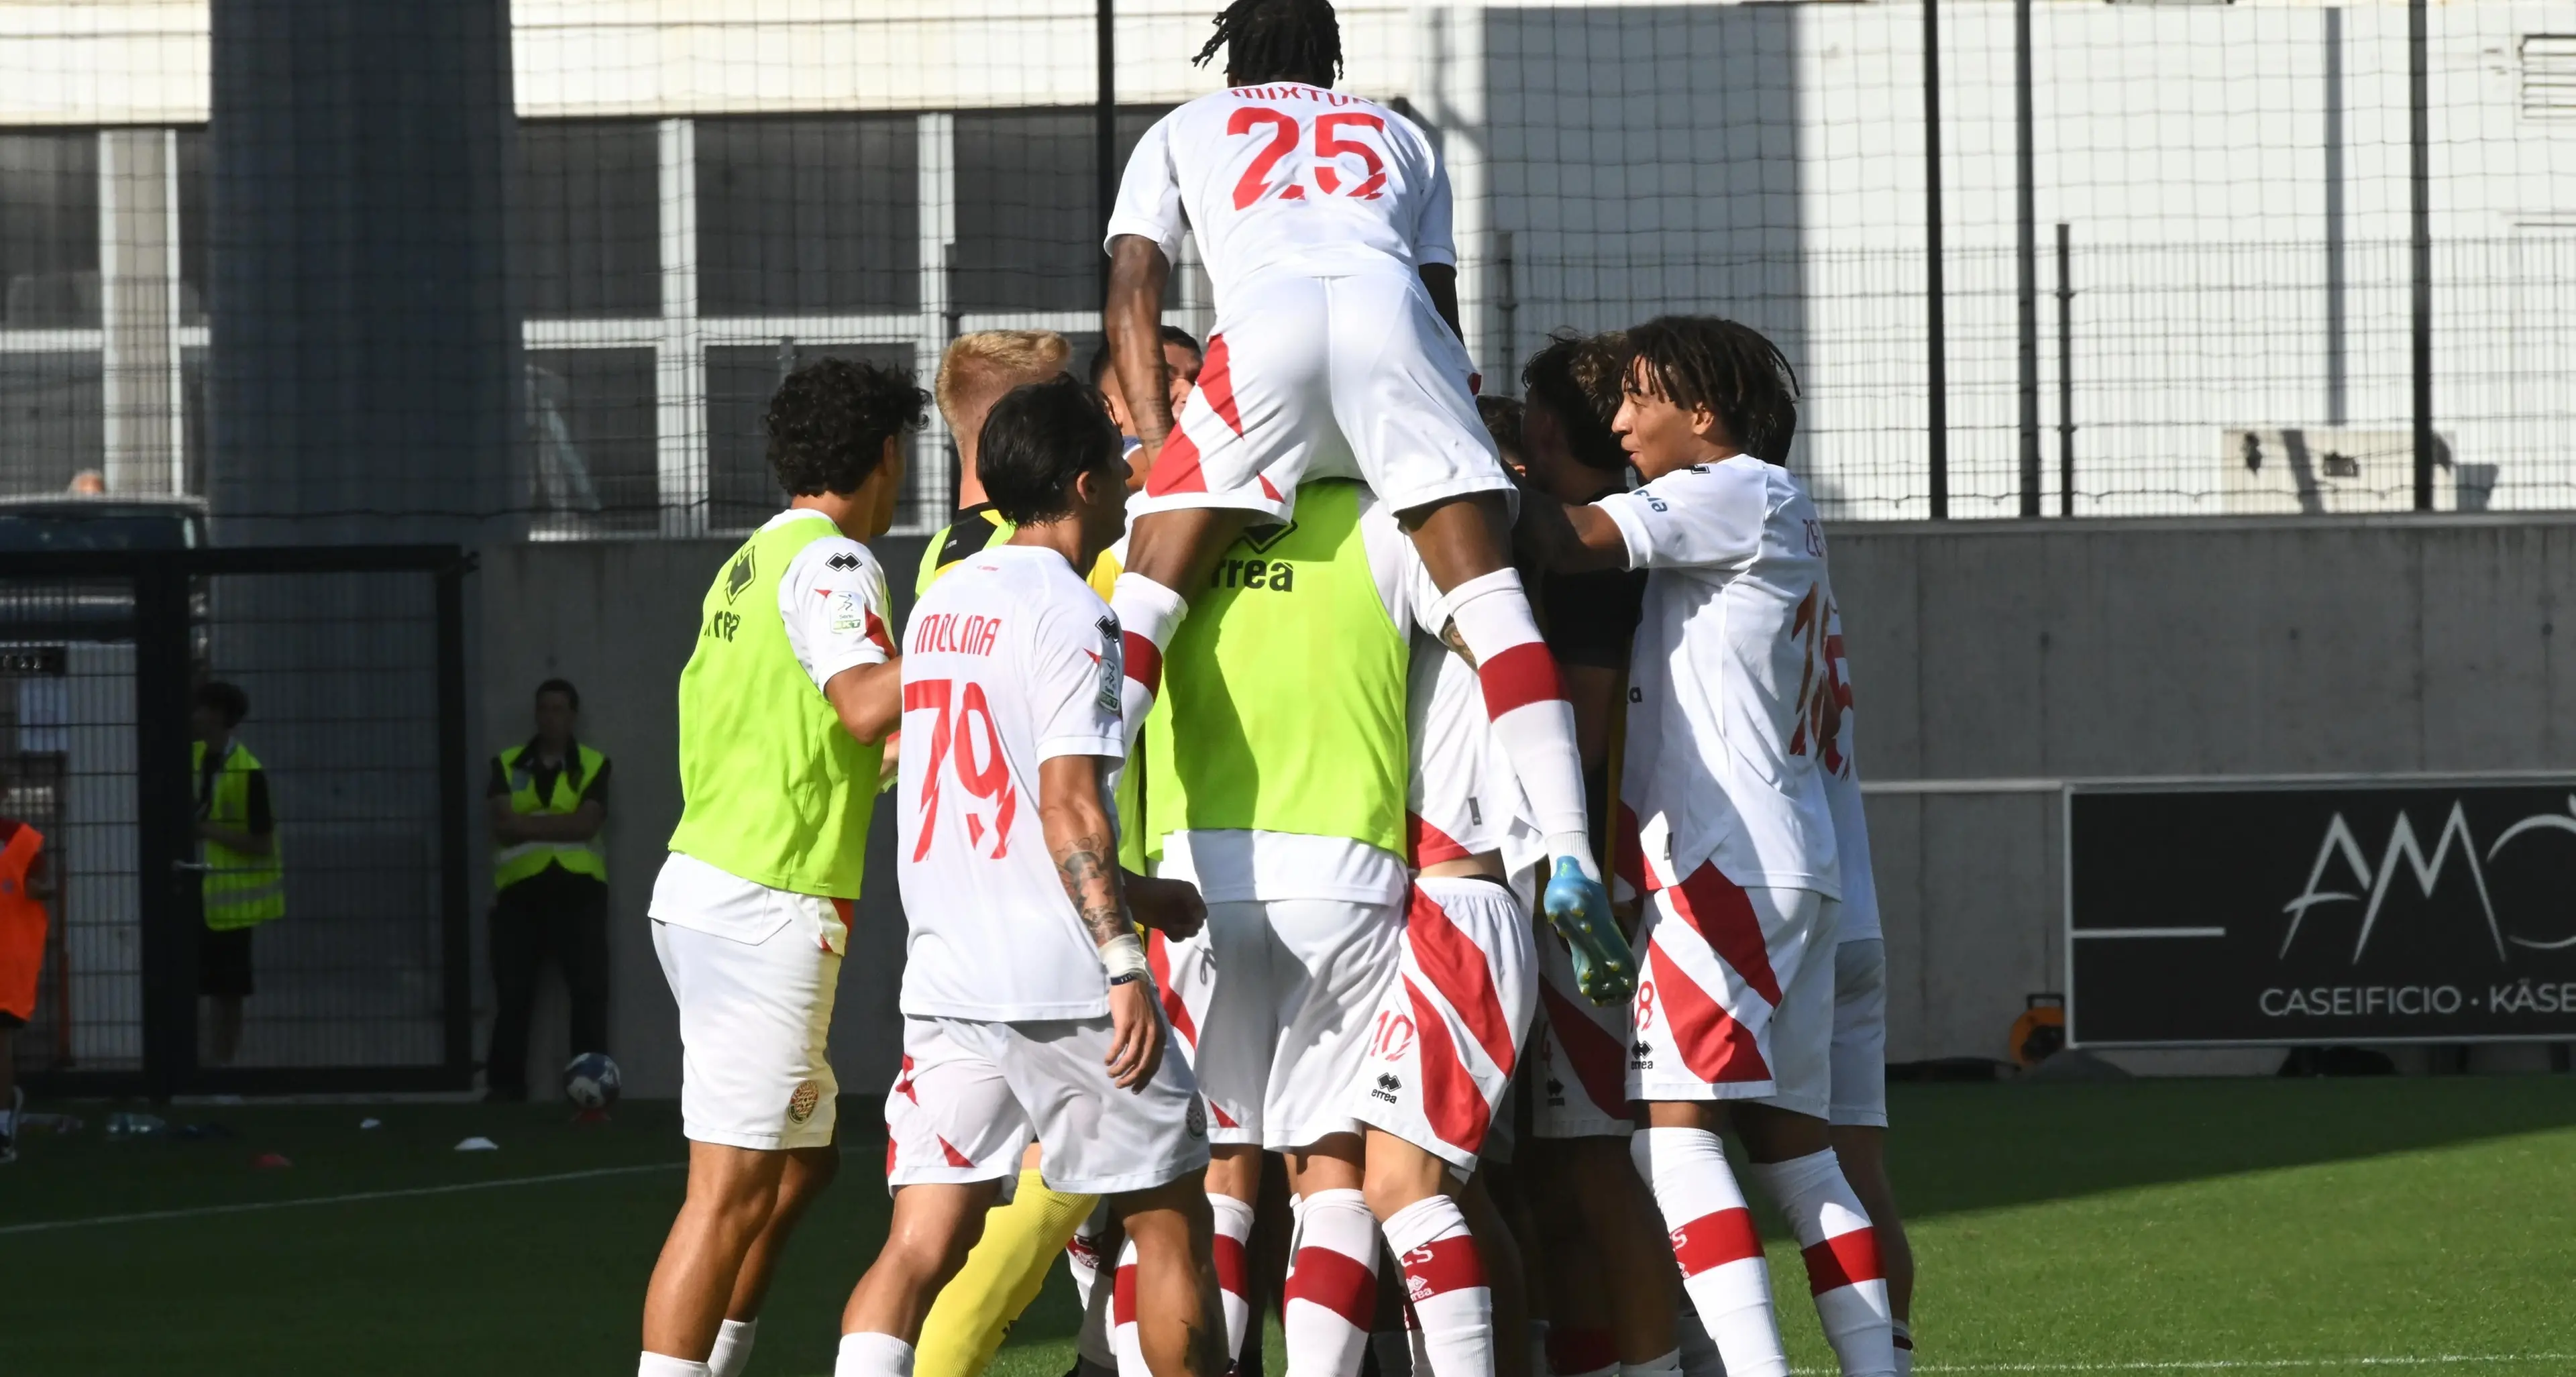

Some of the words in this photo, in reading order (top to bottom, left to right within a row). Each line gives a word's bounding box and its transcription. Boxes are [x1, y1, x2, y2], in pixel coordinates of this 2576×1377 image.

[1227, 107, 1387, 211] 25
[914, 612, 1002, 657] MOLINA
[904, 678, 1016, 864] 79
[2259, 985, 2462, 1017] CASEIFICIO
[1369, 1009, 1415, 1062] 10
[1371, 1088, 1397, 1105] errea
